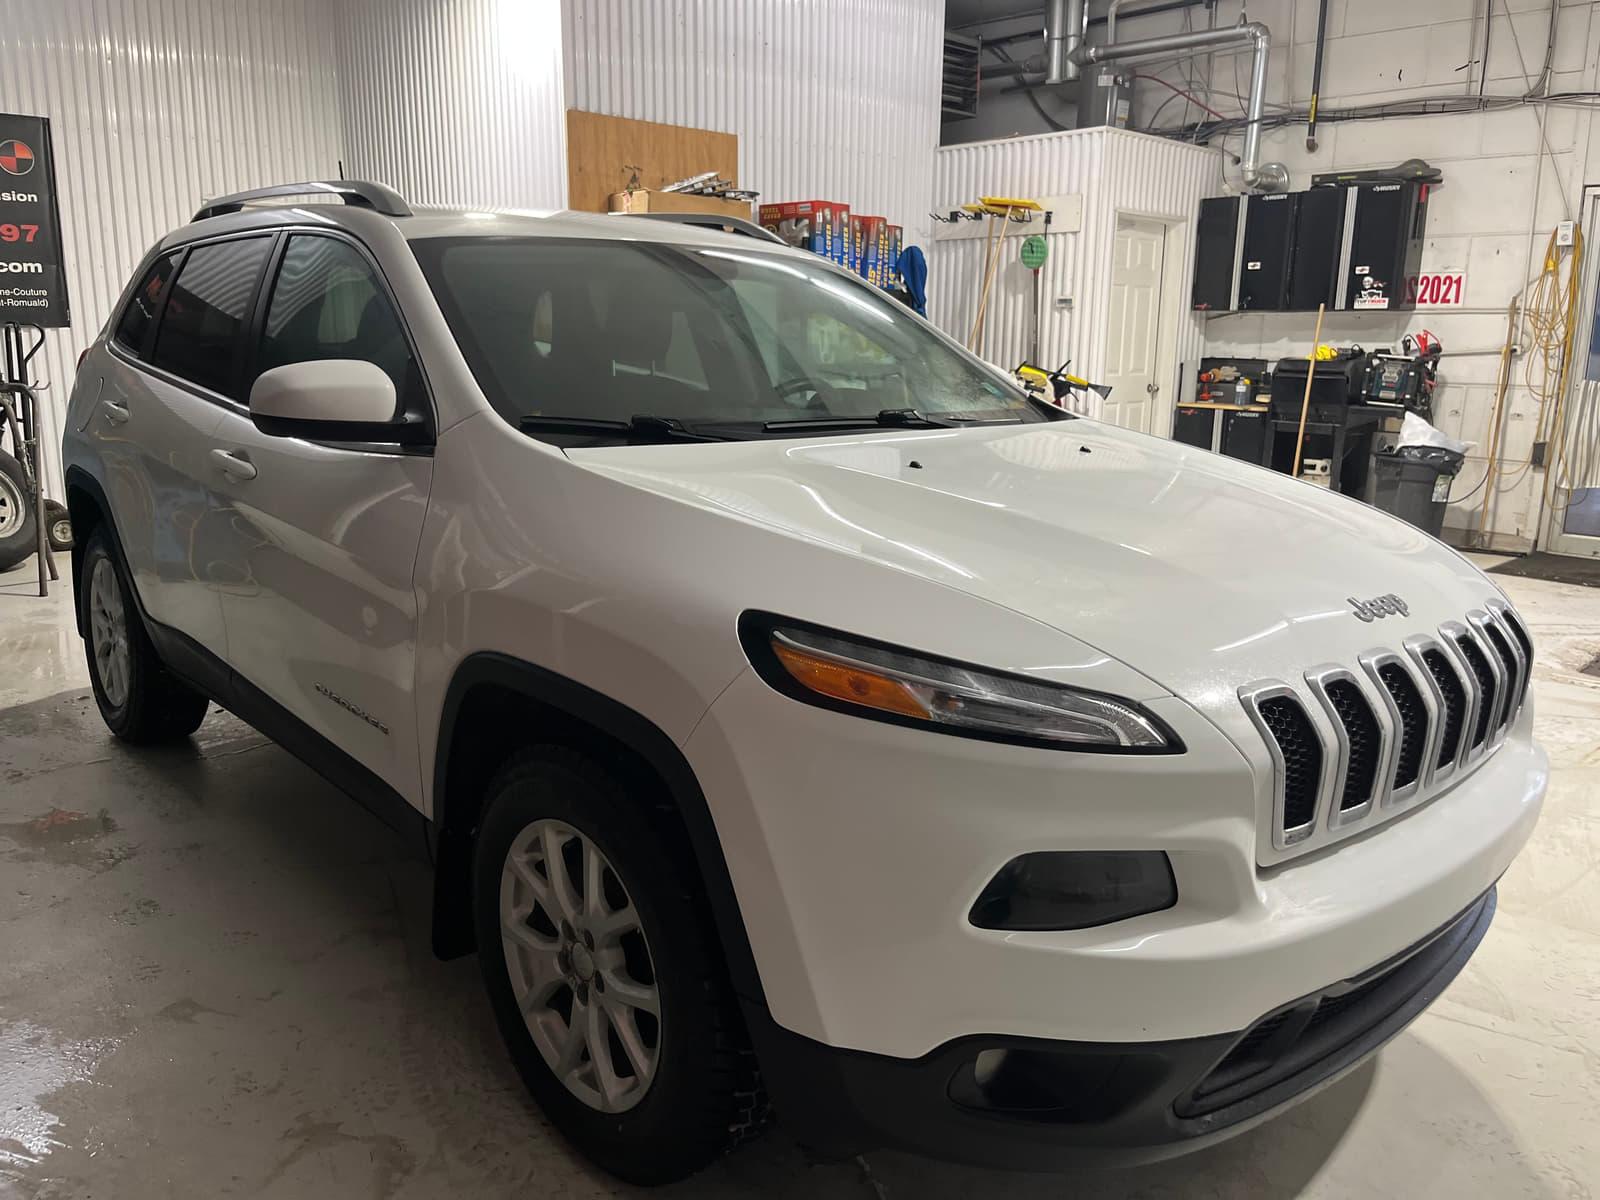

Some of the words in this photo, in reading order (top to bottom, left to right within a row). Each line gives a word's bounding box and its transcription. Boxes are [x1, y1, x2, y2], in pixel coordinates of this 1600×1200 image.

[0, 190, 38, 202] sion
[0, 223, 39, 243] 97
[1417, 275, 1462, 304] 2021
[1346, 594, 1410, 623] Jeep
